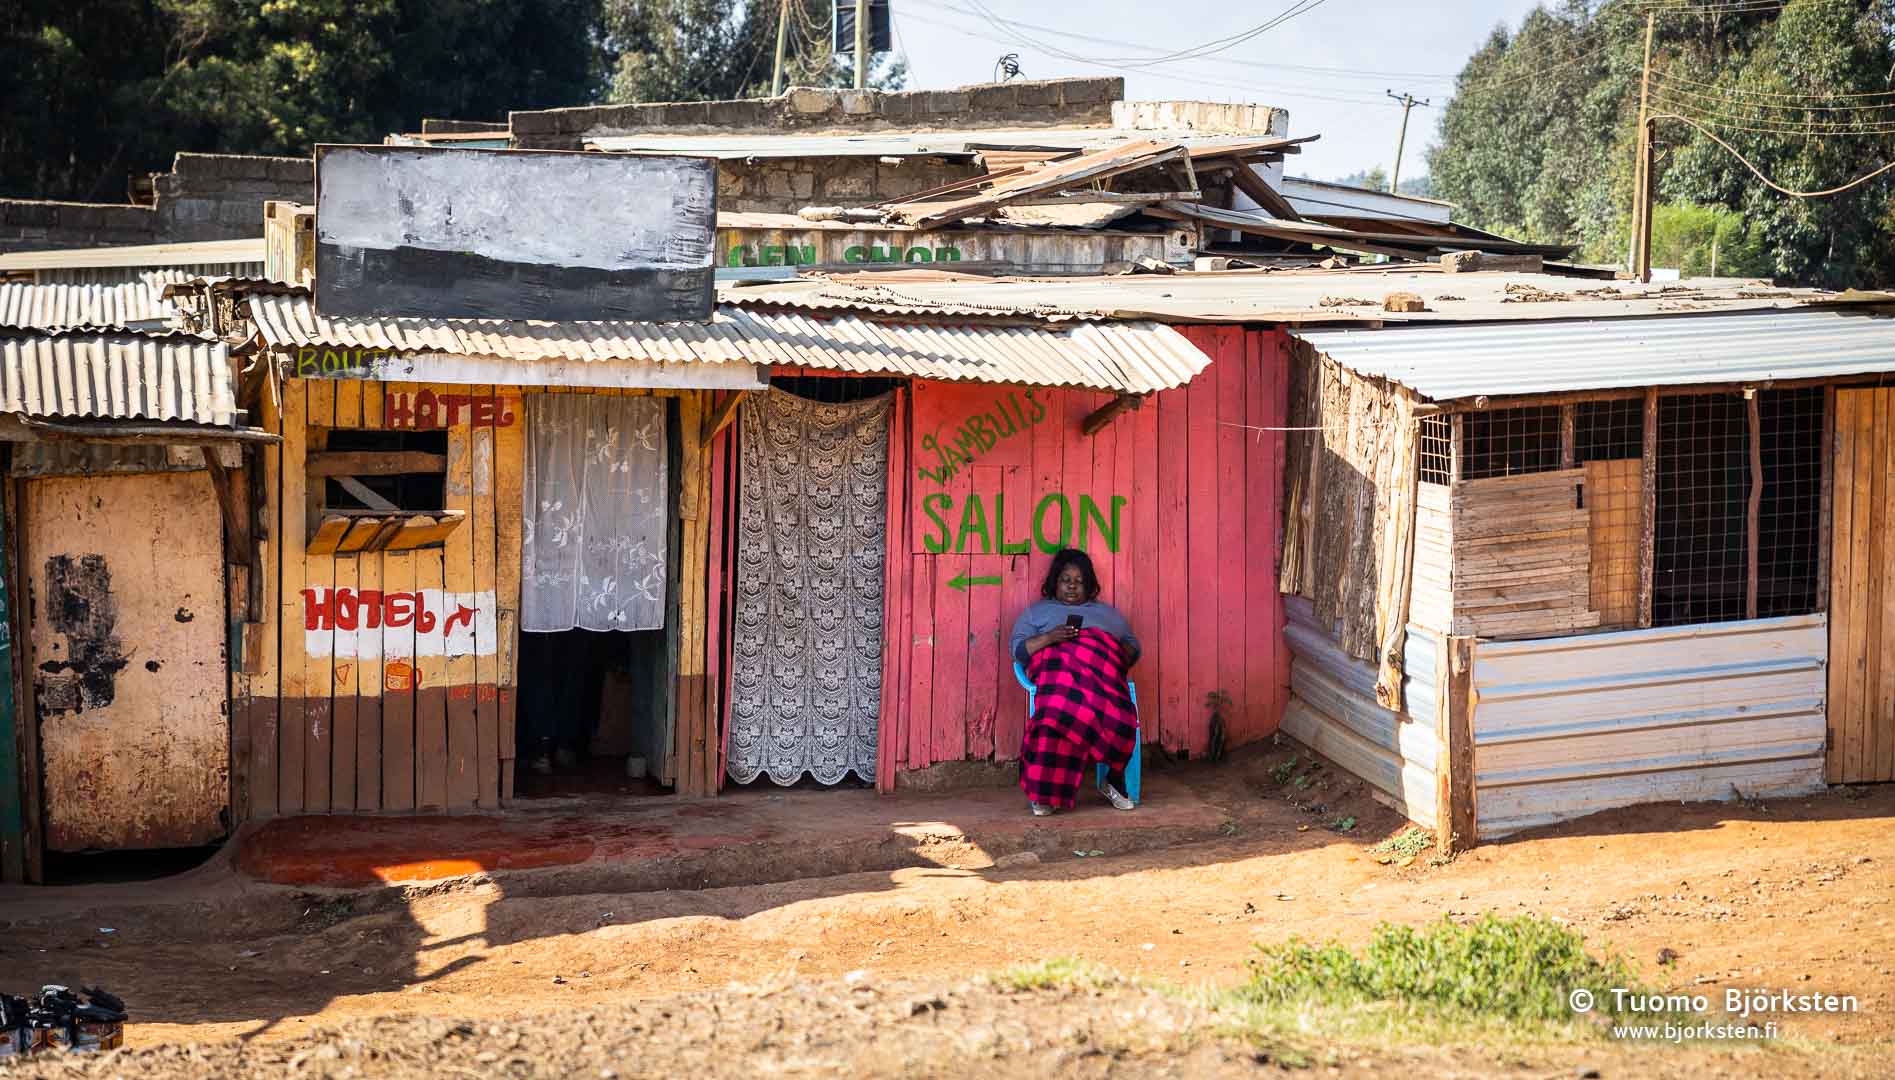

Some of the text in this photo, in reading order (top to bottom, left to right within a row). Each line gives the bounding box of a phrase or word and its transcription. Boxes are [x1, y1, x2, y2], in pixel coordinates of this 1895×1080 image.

[386, 388, 516, 430] HOTEL
[922, 493, 1127, 555] SALON
[300, 588, 436, 634] HOTEL
